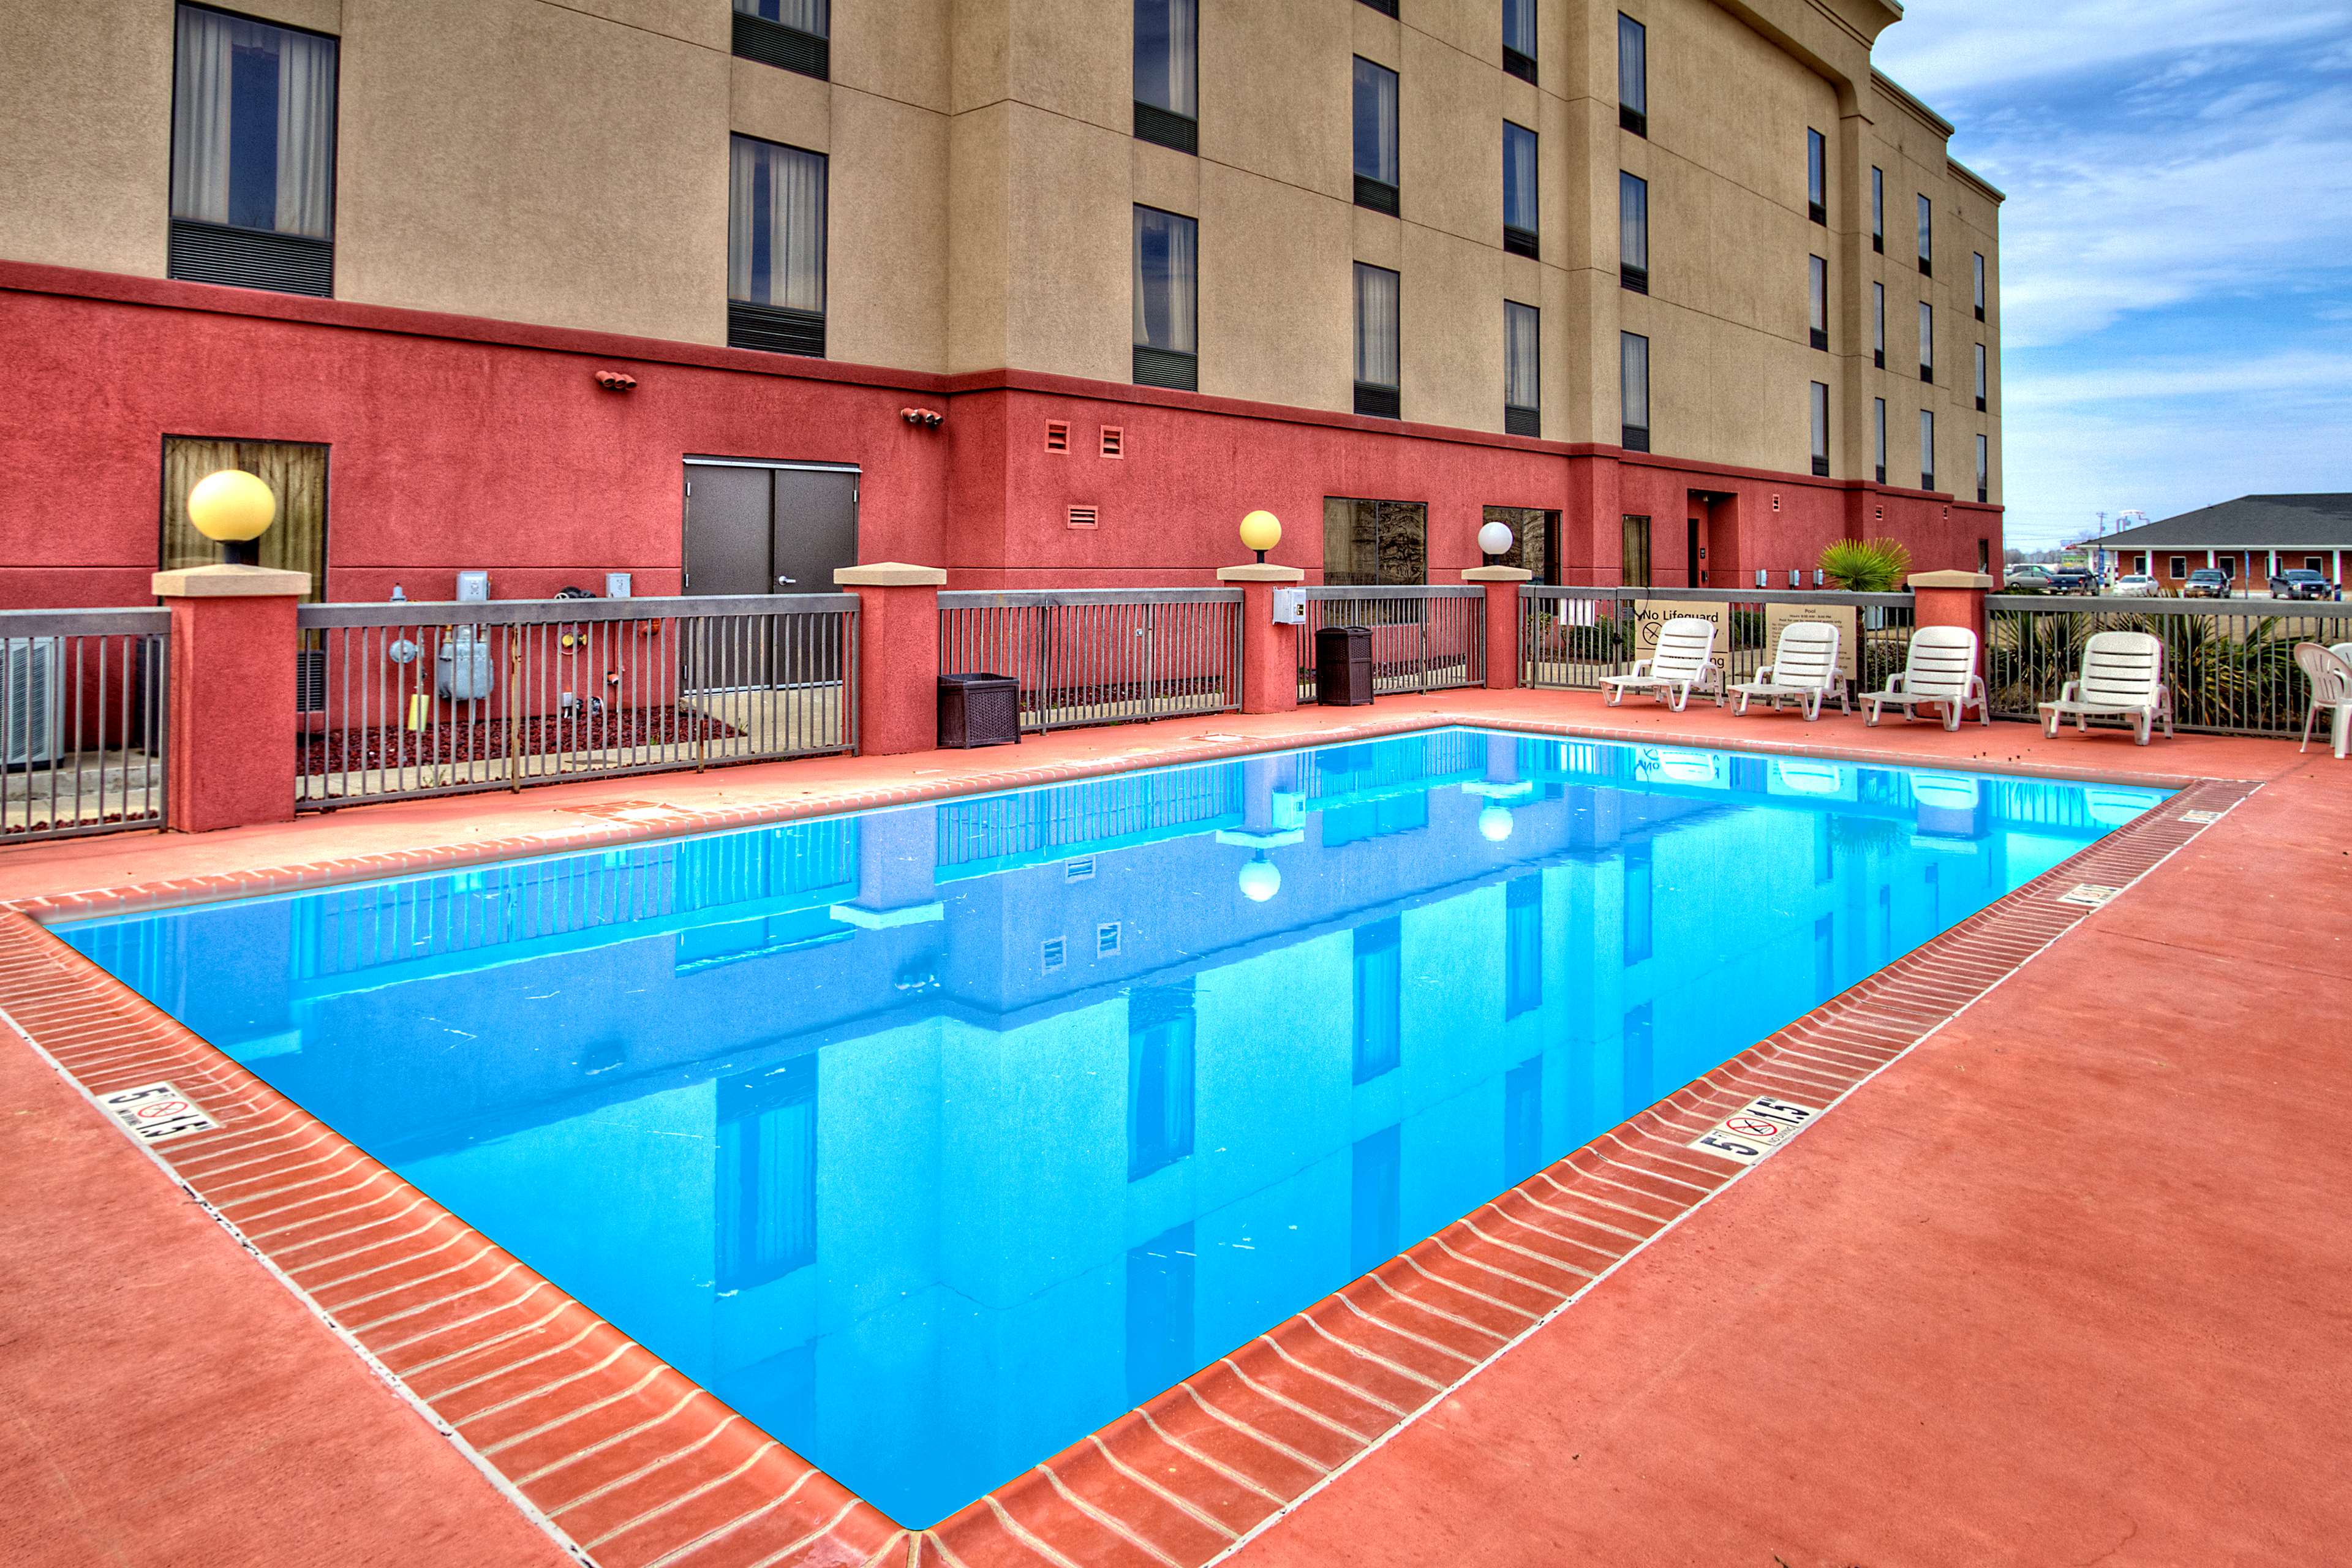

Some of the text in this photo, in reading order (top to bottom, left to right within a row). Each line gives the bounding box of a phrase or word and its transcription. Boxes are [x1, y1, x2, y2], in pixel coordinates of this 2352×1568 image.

[1643, 610, 1659, 620] No
[108, 1087, 170, 1104] 5
[1746, 1100, 1810, 1124] 1.5
[136, 1114, 209, 1137] 1.5
[1775, 1126, 1796, 1138] DIVING
[1700, 1137, 1759, 1156] 5
